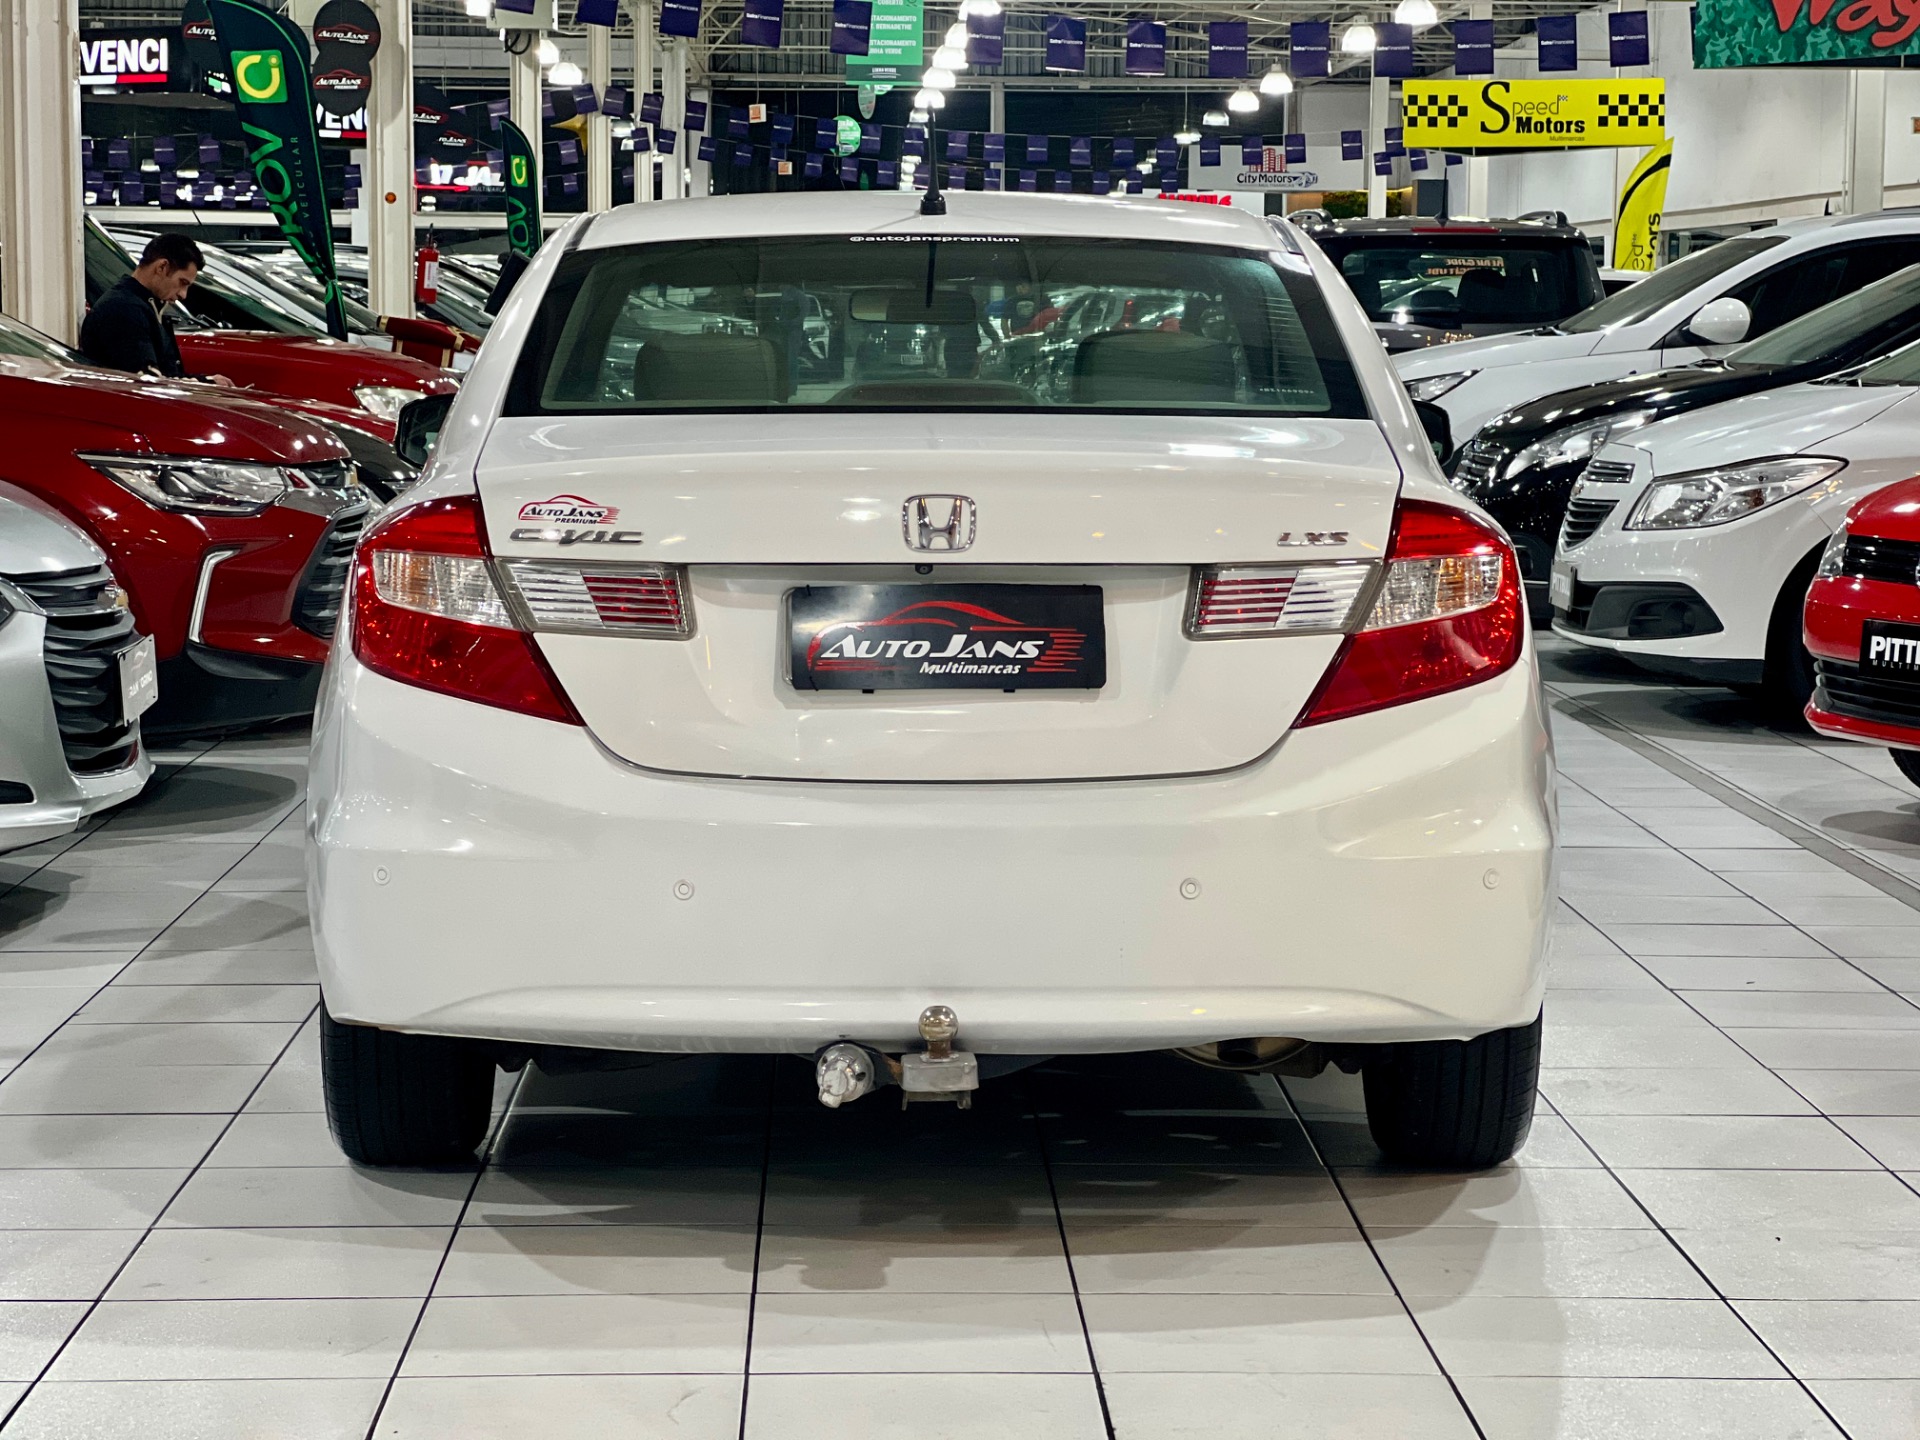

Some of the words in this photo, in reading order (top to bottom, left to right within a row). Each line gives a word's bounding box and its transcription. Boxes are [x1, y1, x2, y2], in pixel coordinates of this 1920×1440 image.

[1516, 116, 1585, 133] Motors
[1237, 173, 1258, 183] City
[1259, 173, 1293, 183] Motors
[849, 235, 1020, 243] @autojanspremium
[509, 528, 643, 545] CIVIC
[1277, 531, 1349, 546] LXS
[1869, 635, 1920, 665] PITT
[919, 661, 1021, 675] Multimarcas
